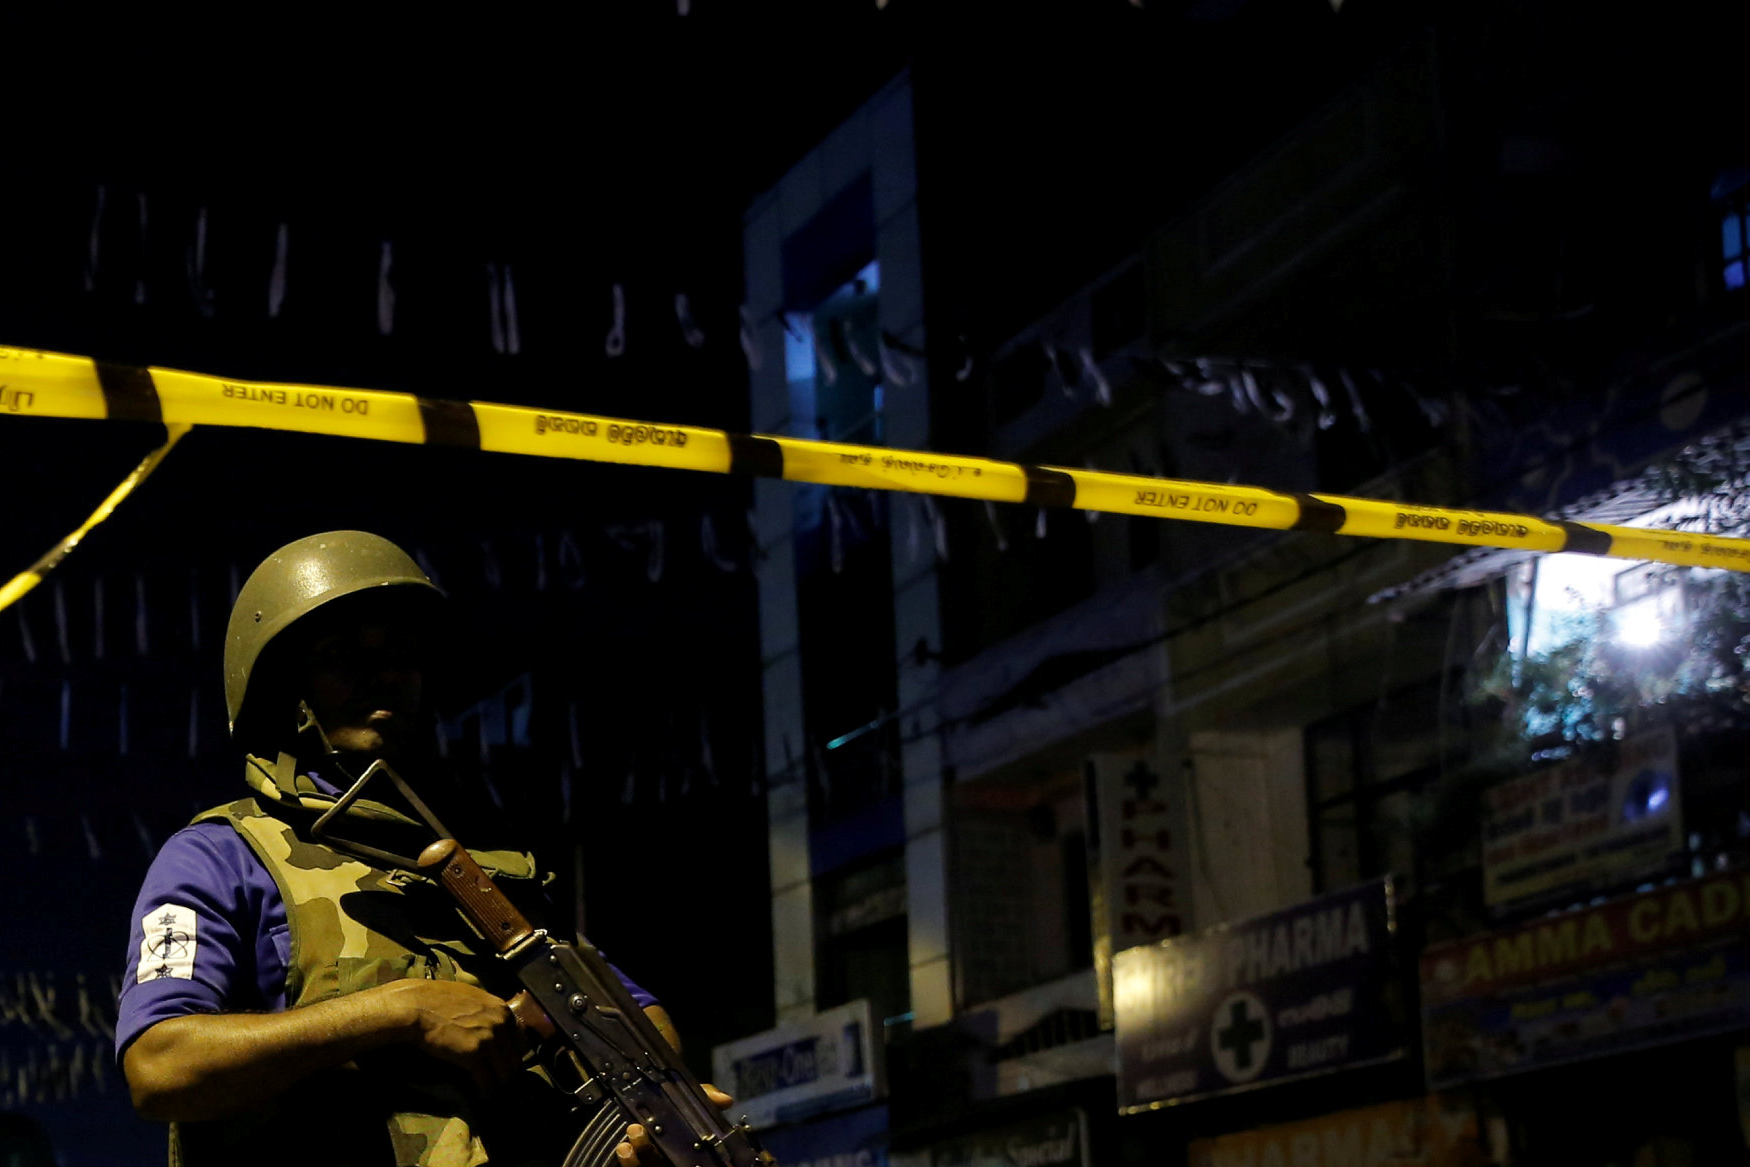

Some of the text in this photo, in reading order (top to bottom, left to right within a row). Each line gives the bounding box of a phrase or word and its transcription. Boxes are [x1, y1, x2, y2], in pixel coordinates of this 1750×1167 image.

[222, 384, 369, 415] DO NOT ENTER
[1134, 491, 1258, 516] DO NOT ENTER
[1228, 900, 1371, 986] PHARMA
[1464, 914, 1613, 985] AMMA
[1626, 874, 1750, 943] CAD
